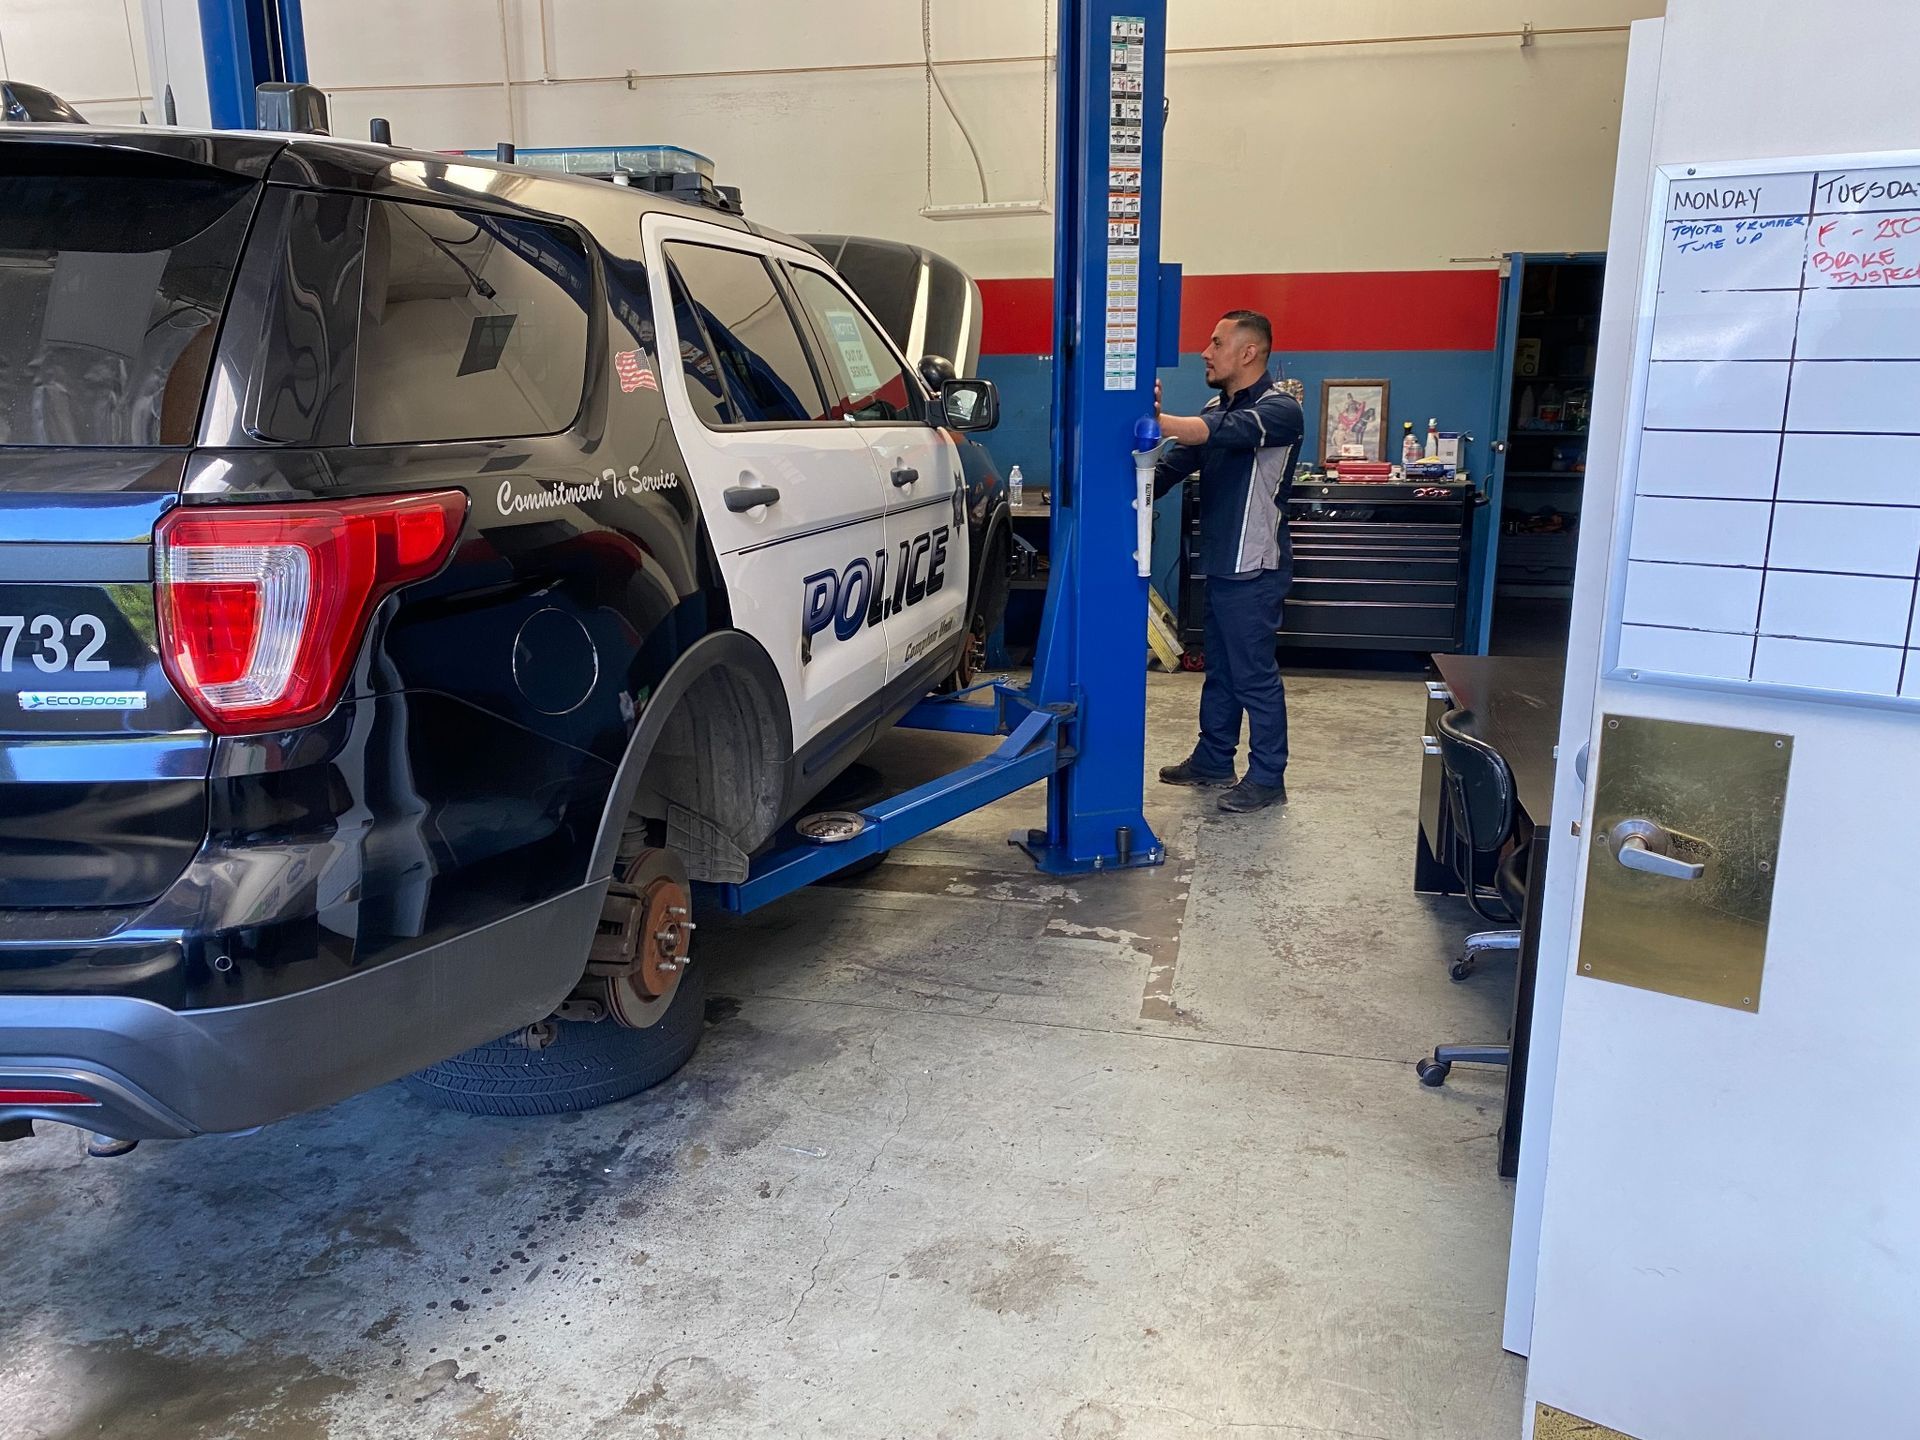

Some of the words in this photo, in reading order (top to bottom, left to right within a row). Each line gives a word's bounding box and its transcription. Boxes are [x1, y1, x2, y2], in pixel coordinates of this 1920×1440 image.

[1674, 187, 1762, 214] MONDAY
[1672, 223, 1723, 241] TOYOTA
[1735, 216, 1806, 232] 4RUNNER
[1678, 239, 1726, 254] TUNE
[1736, 232, 1763, 244] UP
[1812, 248, 1895, 273] BRAKE
[496, 477, 603, 516] Commitment
[602, 468, 627, 498] To
[628, 465, 678, 494] Service
[802, 525, 949, 666] POLICE
[0, 614, 110, 673] 732
[904, 630, 939, 664] Compton
[46, 696, 139, 706] ECOBOOST
